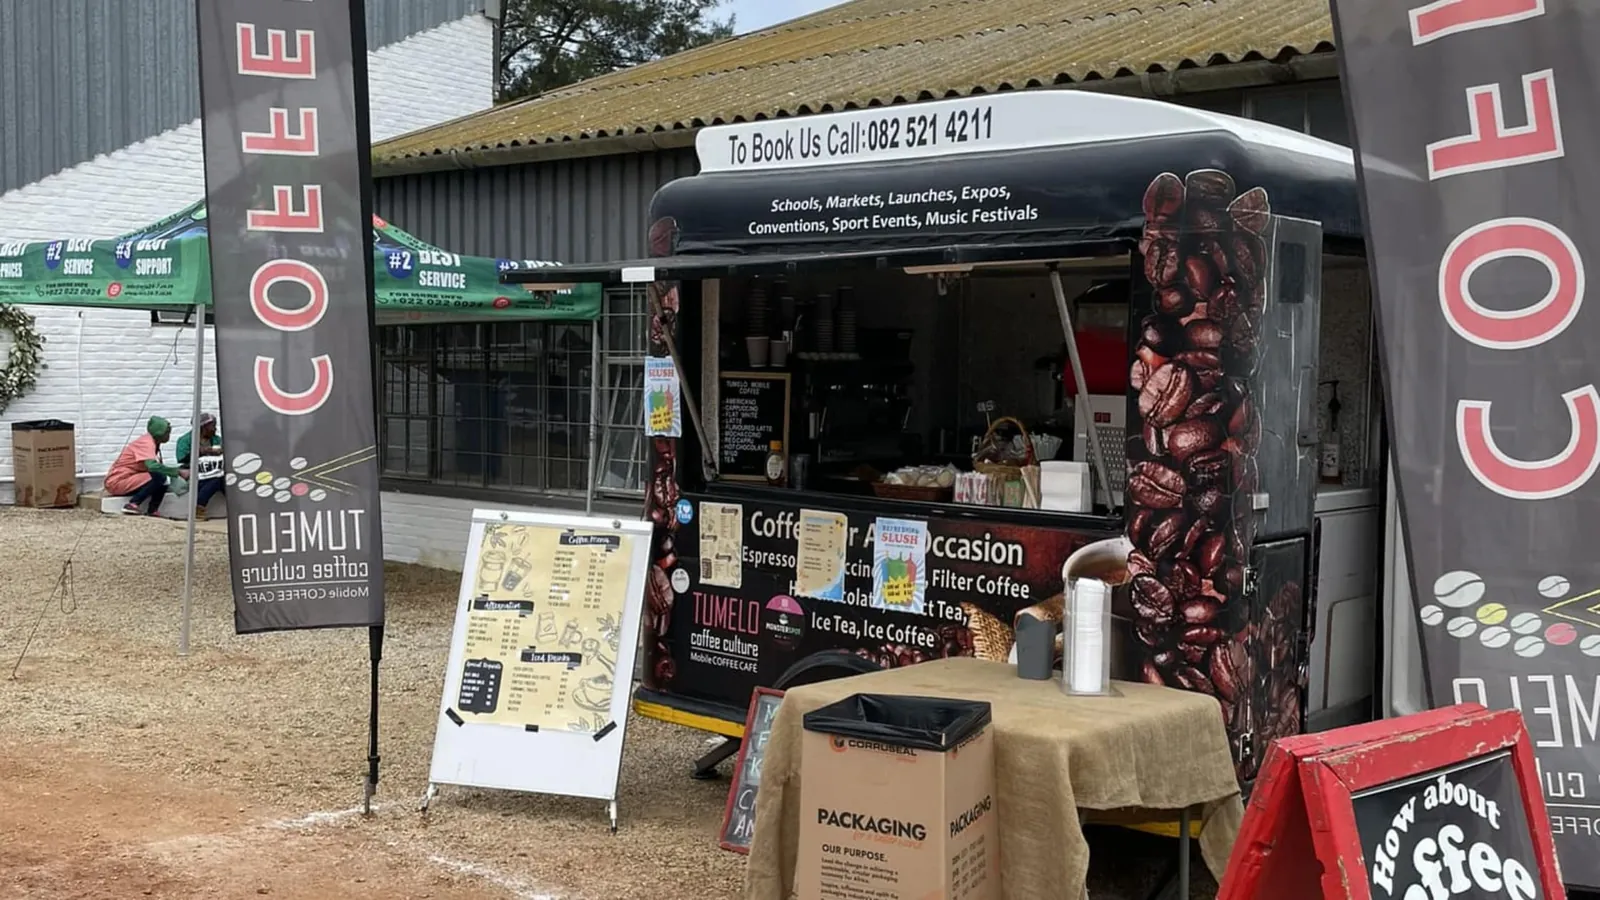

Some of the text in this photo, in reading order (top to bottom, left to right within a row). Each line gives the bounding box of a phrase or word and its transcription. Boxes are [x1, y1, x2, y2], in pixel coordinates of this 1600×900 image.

[729, 135, 746, 165] To
[752, 129, 794, 163] Book
[800, 127, 821, 159] Us
[906, 113, 938, 149] 521
[946, 106, 993, 143] 4211
[771, 185, 1012, 213] Schools, Markets, Launches, Expos,
[748, 205, 1038, 236] Conventions, Sport Events, Music Festivals
[46, 241, 63, 261] #2
[66, 239, 96, 252] BEST
[115, 241, 132, 259] #3
[63, 258, 95, 275] SERVICE
[136, 257, 172, 275] SUPPORT
[389, 252, 412, 270] #2
[418, 270, 466, 289] SERVICE
[391, 297, 424, 305] +022
[427, 298, 450, 306] 022
[751, 510, 800, 540] Coffe
[881, 532, 918, 545] SLUSH
[742, 545, 796, 568] Espresso
[932, 568, 973, 591] Filter
[976, 573, 1030, 600] Coffee
[693, 591, 760, 635] TUMELO
[938, 603, 968, 626] Tea,
[811, 611, 936, 648] Ice Tea, Ice Coffee
[690, 628, 759, 658] coffee culture
[818, 808, 927, 841] PACKAGING
[950, 795, 992, 840] PACKAGING
[1373, 797, 1417, 896] How
[1424, 775, 1501, 830] about
[822, 843, 889, 863] OUR PURPOSE.
[844, 861, 862, 869] change
